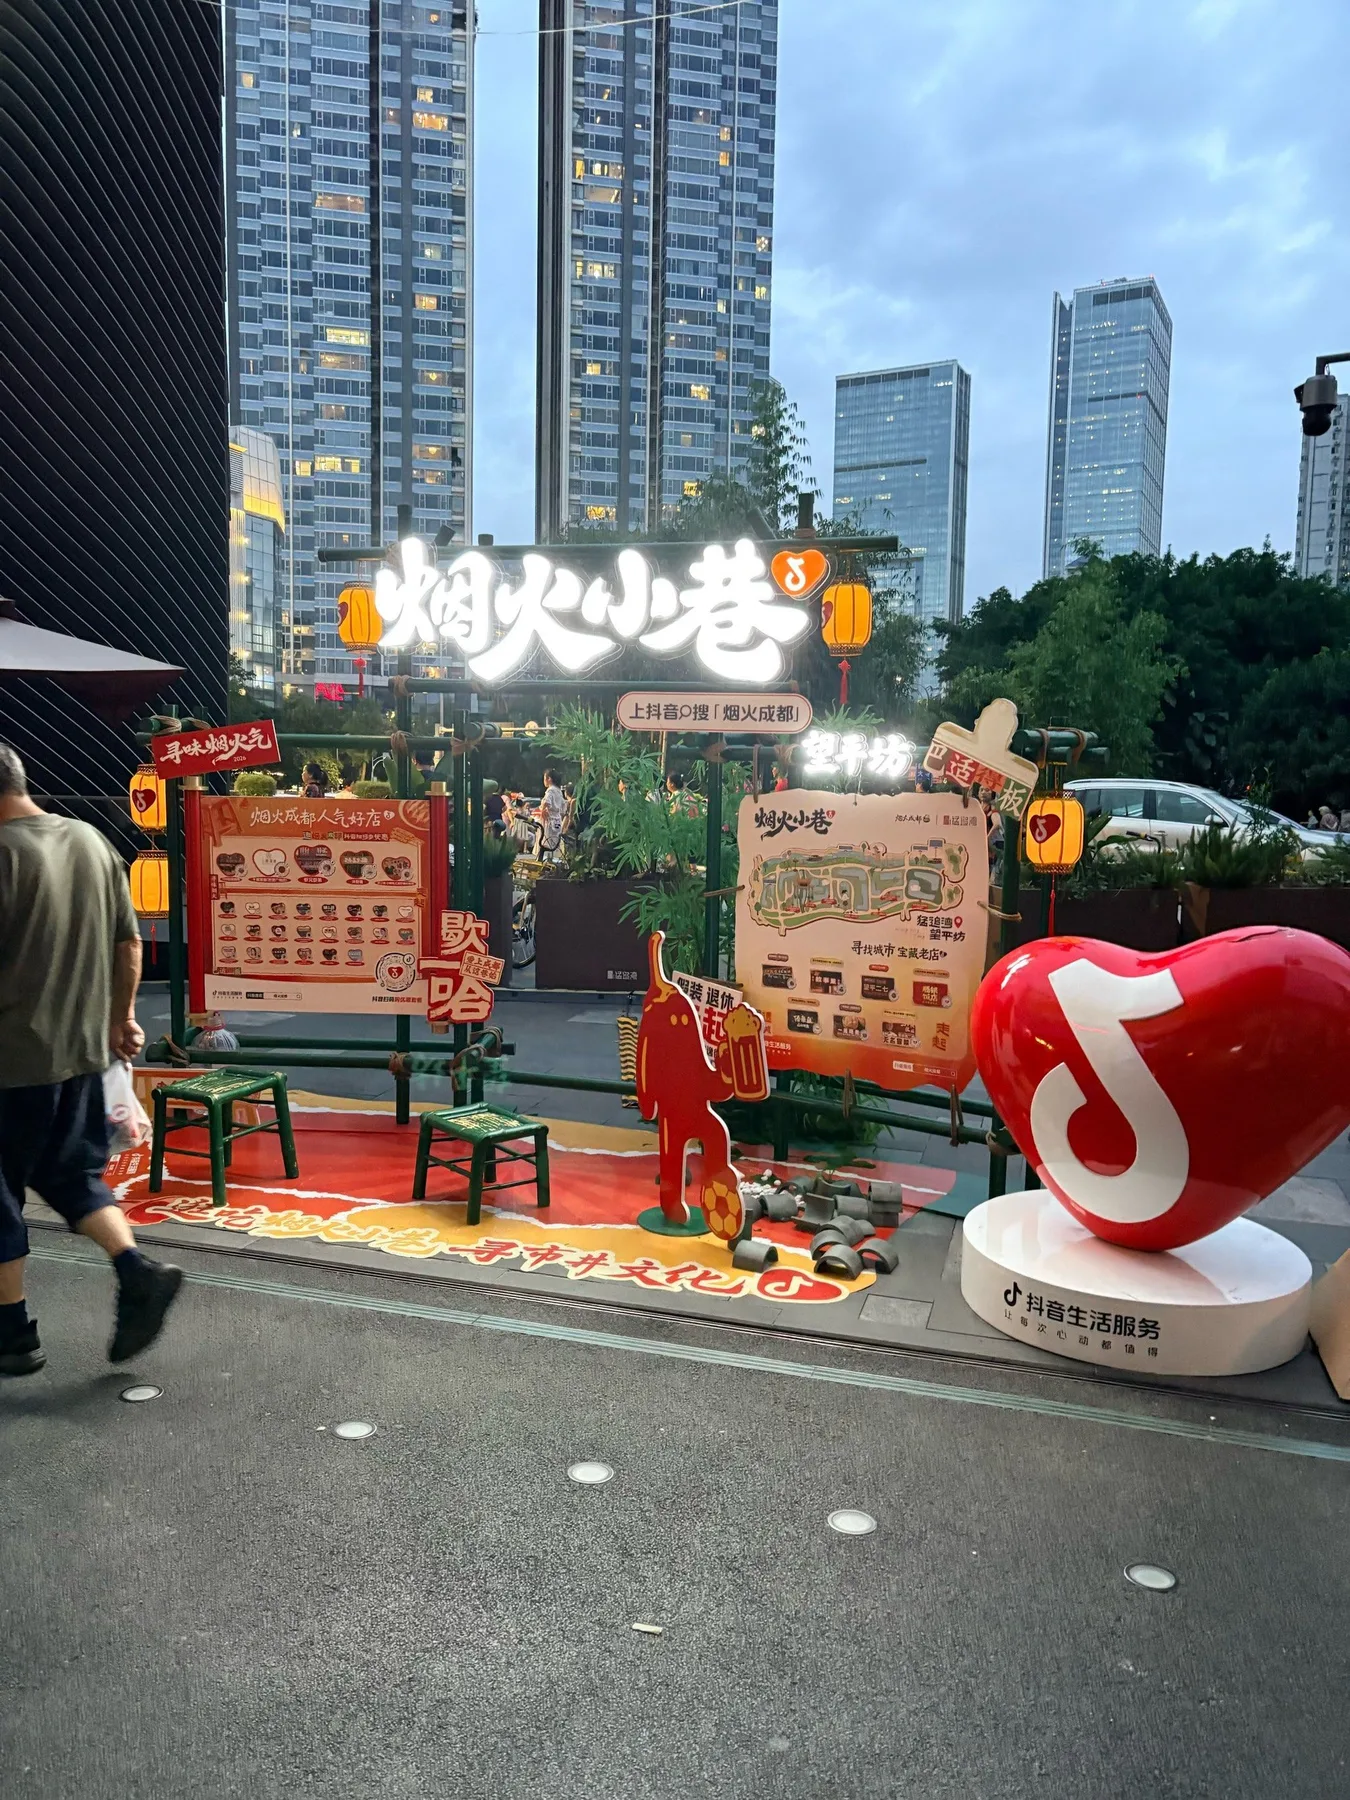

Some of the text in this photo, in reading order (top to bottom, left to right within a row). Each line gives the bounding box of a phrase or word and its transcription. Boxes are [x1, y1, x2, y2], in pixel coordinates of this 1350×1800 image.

[375, 537, 809, 682] 烟火小巷
[160, 727, 273, 766] 寻味烟火气
[801, 729, 912, 777] 望平坊
[928, 743, 1028, 819] 巴适得板
[250, 807, 381, 829] 烟火成都人气好店
[755, 807, 833, 841] 烟火小巷
[917, 915, 952, 929] 猛追湾
[929, 928, 965, 942] 望平坊
[420, 911, 492, 1020] 歇一哈
[851, 941, 940, 961] 寻找城市 宝藏老店
[932, 1022, 950, 1051] 走起
[1004, 1309, 1158, 1357] 让每次心动都值得
[1026, 1292, 1161, 1340] 抖音生活服务
